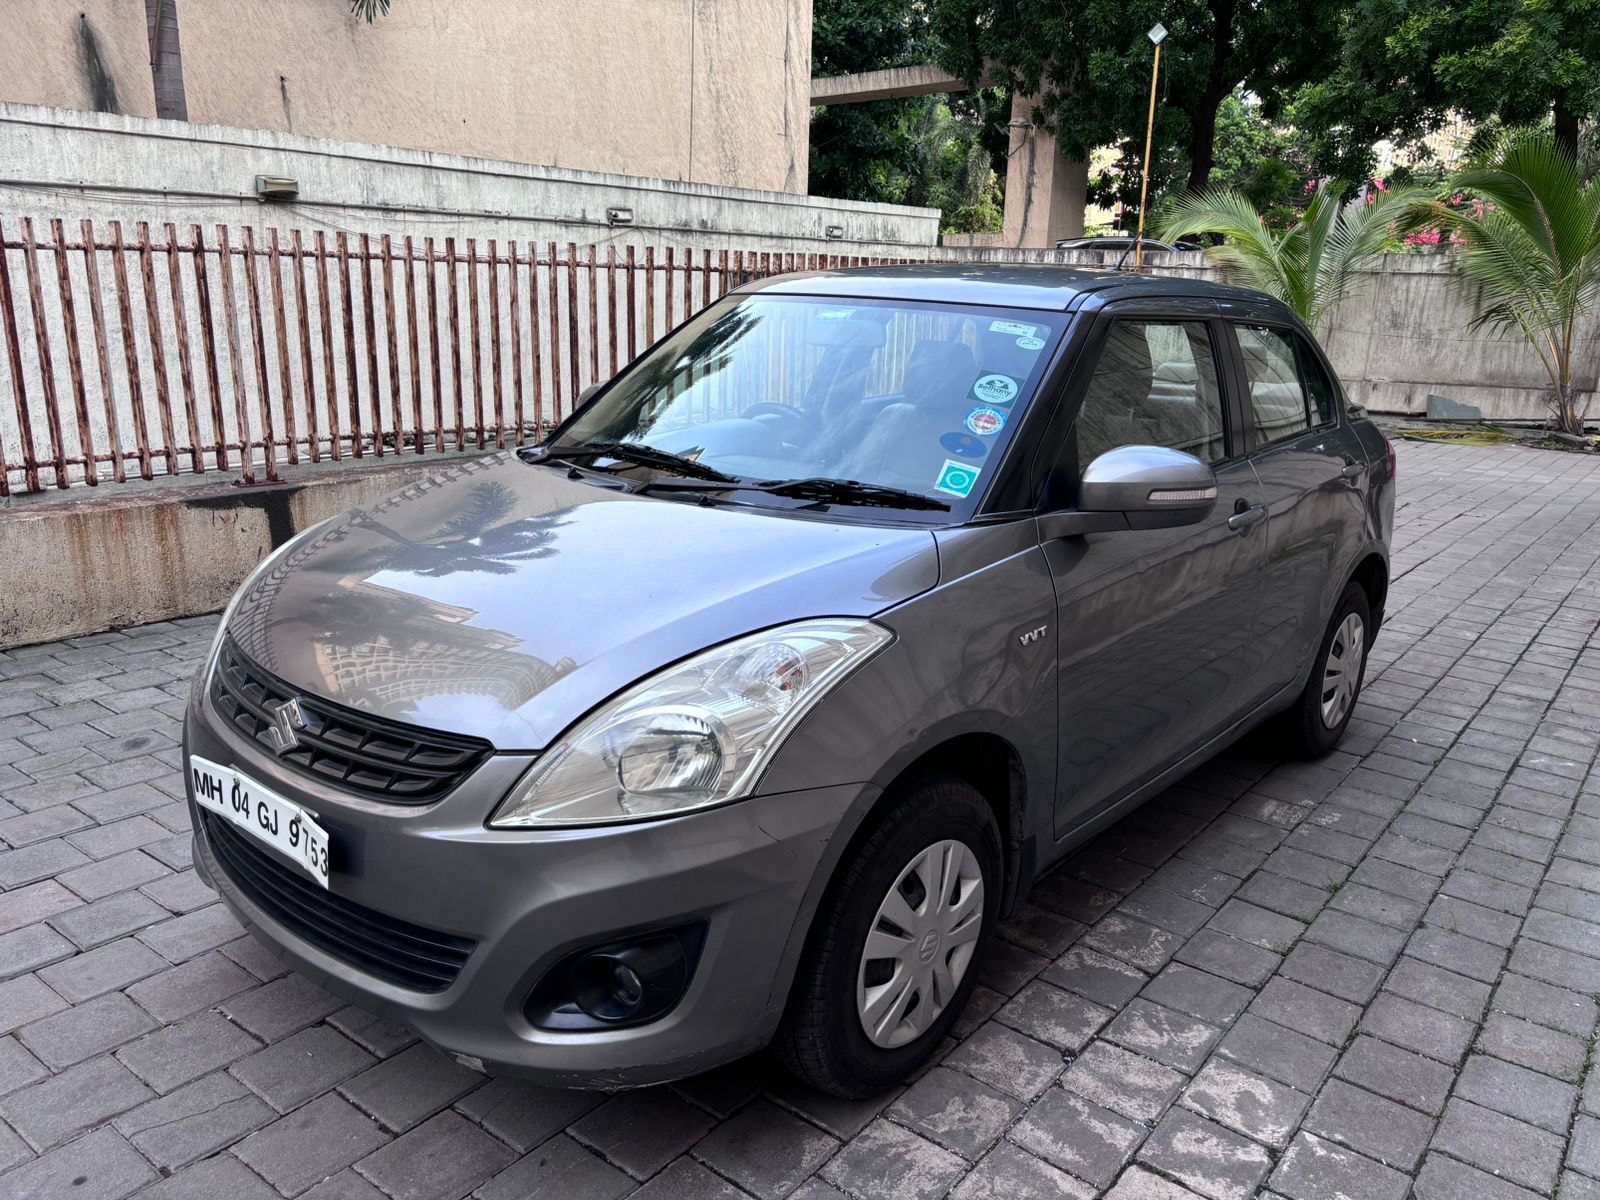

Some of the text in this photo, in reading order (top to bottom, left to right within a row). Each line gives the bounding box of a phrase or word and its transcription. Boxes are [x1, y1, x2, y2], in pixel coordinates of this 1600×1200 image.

[978, 383, 1012, 397] Bethany
[1019, 625, 1047, 646] VVT
[193, 767, 328, 877] MH 04 GJ 9753
